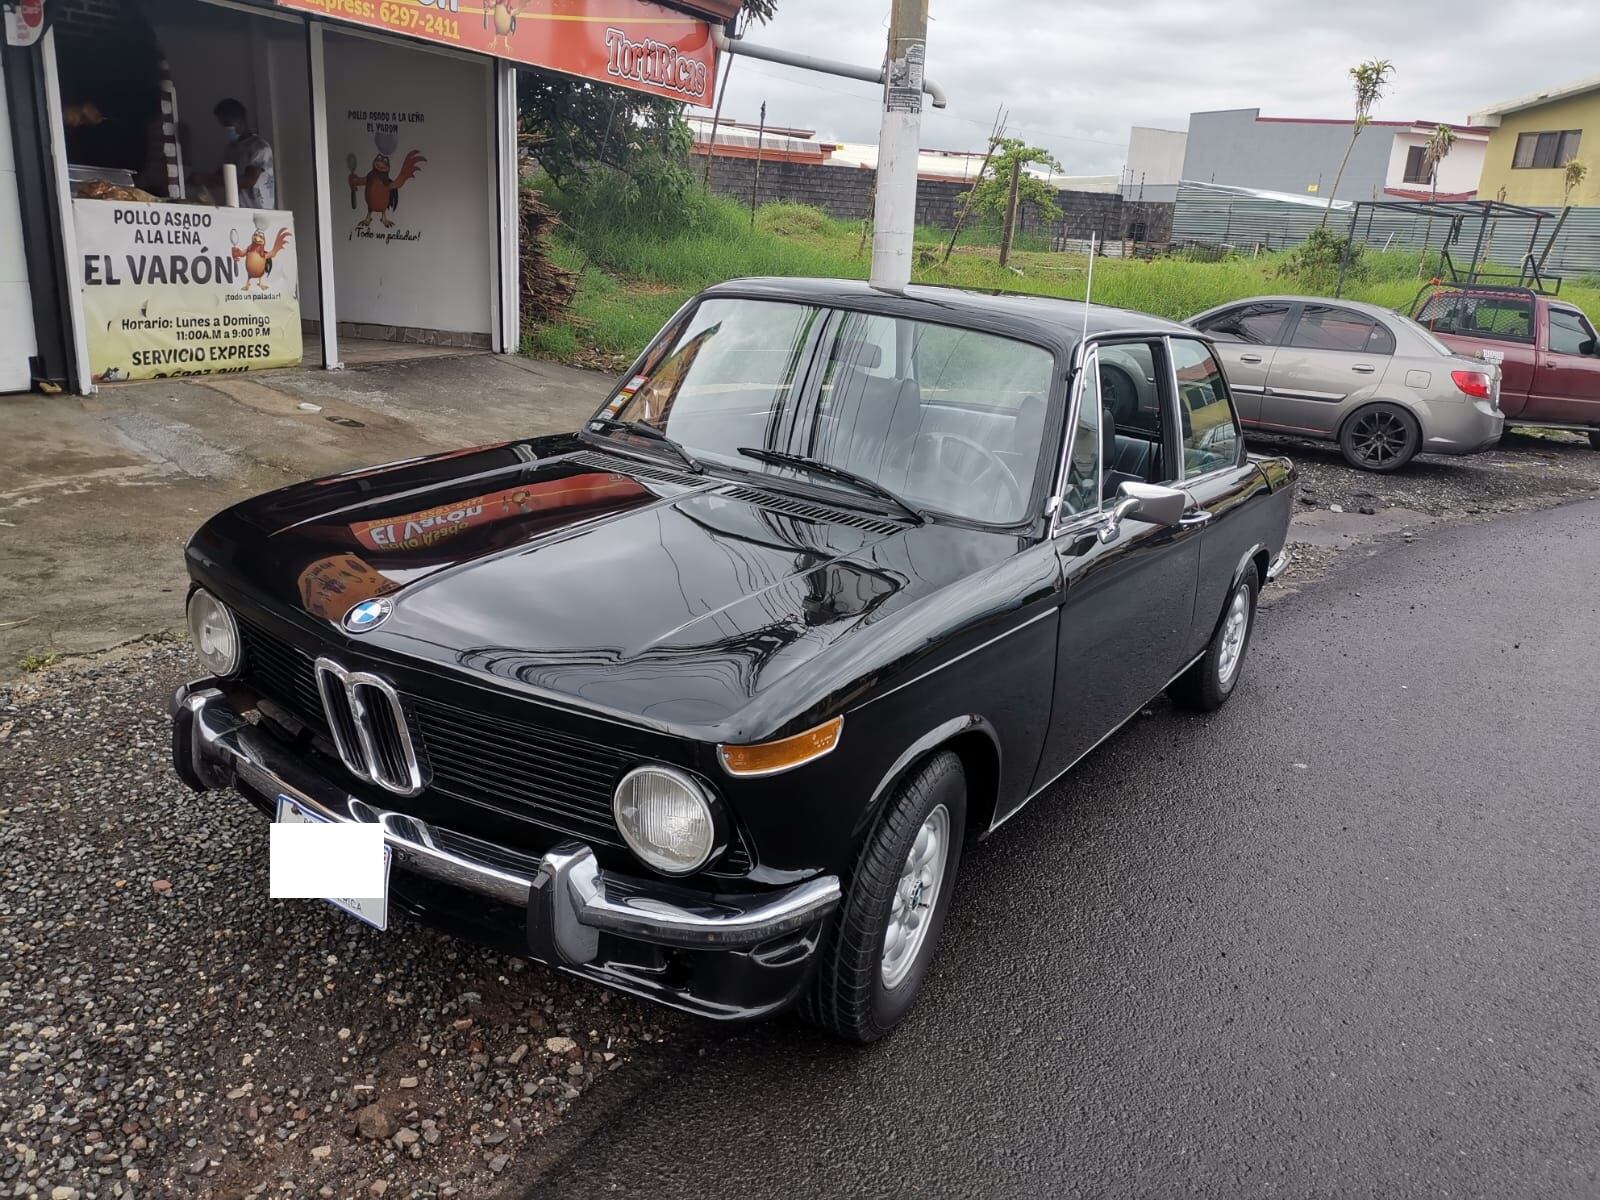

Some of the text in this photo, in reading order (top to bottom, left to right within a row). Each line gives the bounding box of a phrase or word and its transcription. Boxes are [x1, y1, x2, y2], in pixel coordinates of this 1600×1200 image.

[379, 2, 460, 40] 6297-2411
[605, 26, 707, 97] TortiRicas
[347, 110, 368, 120] POLLO
[369, 111, 390, 122] ASADO
[392, 112, 397, 121] A
[398, 112, 406, 122] LA
[114, 209, 212, 228] POLLO ASADO
[134, 225, 202, 245] A LA LEÑA
[84, 246, 234, 286] EL VARÓN
[252, 292, 281, 302] paladar!
[121, 314, 270, 331] Horario: Lunes a Domingo
[224, 331, 230, 339] a
[232, 328, 253, 338] 9:00
[255, 327, 270, 337] P.M
[132, 344, 270, 366] SERVICIO EXPRESS
